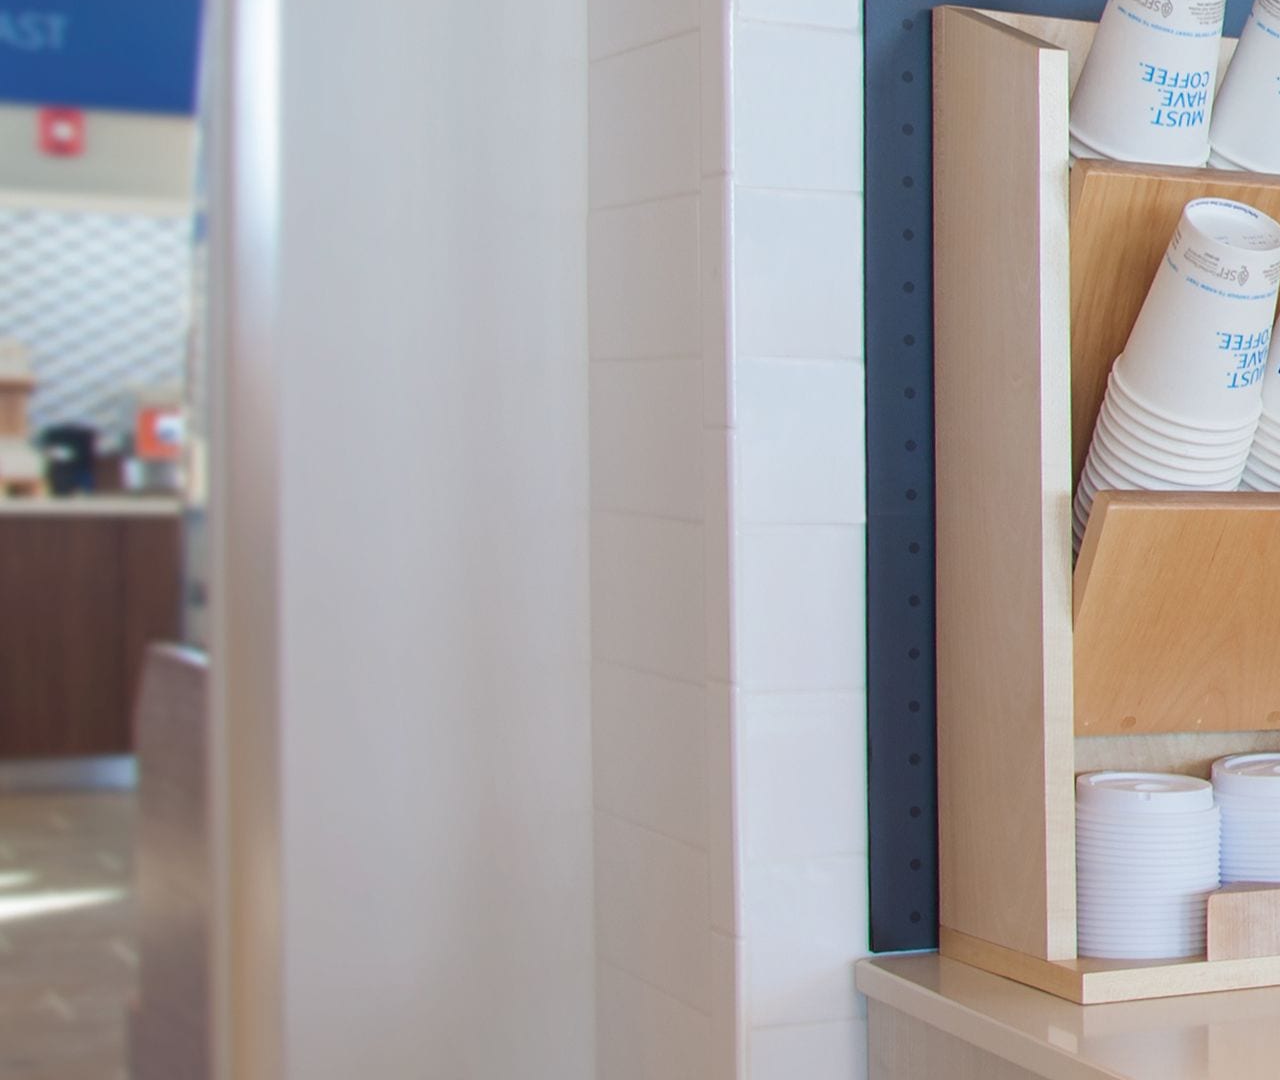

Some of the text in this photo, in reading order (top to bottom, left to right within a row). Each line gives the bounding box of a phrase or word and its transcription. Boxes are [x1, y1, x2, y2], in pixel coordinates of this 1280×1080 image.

[1139, 62, 1210, 89] COFFEE.
[1158, 89, 1207, 108] HAVE.
[1150, 107, 1204, 127] MUST.
[1216, 329, 1269, 350] OFFEE.
[1234, 347, 1267, 369] AVE.
[1227, 366, 1264, 388] UST.
